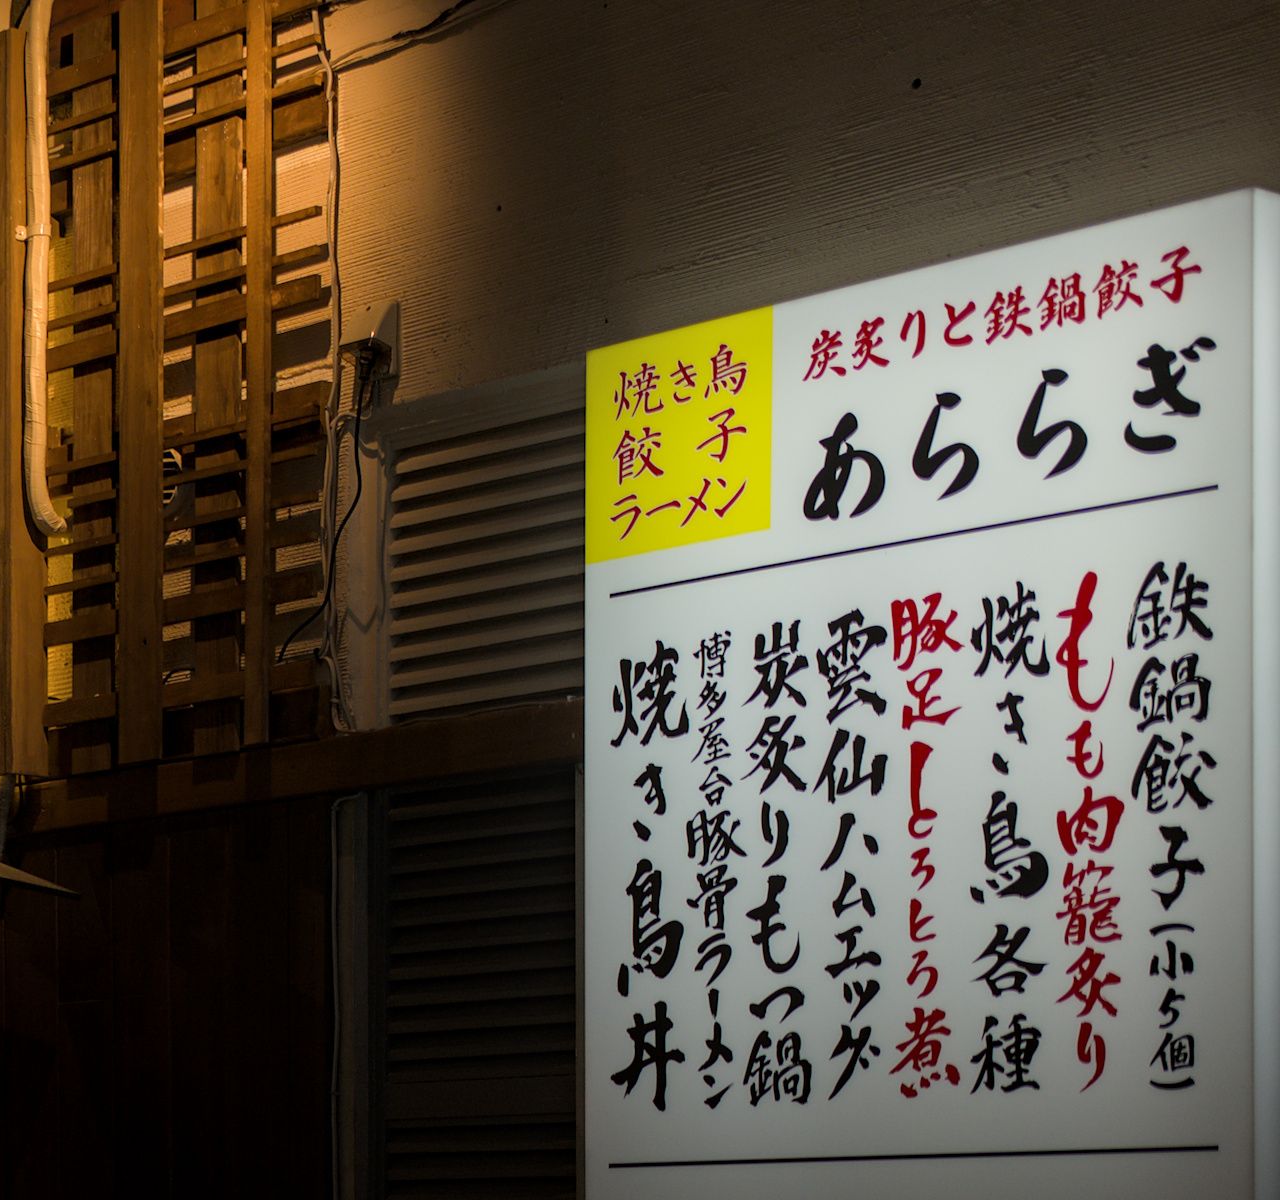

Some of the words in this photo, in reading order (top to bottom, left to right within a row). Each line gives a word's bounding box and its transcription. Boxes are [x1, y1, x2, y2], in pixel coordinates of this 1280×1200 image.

[612, 344, 746, 422] 焼き鳥
[612, 409, 748, 486] 餃子
[802, 246, 1203, 382] 炭炙りと鉄鍋餃子
[802, 336, 1217, 521] あららぎ
[610, 476, 749, 541] ラーメン
[610, 640, 690, 1112] 焼き鳥丼
[740, 620, 813, 1108] 炭炙りもつ鍋
[812, 608, 889, 1101] 雲仙ハムエッグ
[970, 581, 1050, 1094] 焼き鳥各種
[1056, 571, 1124, 1092] もも肉籠炙り
